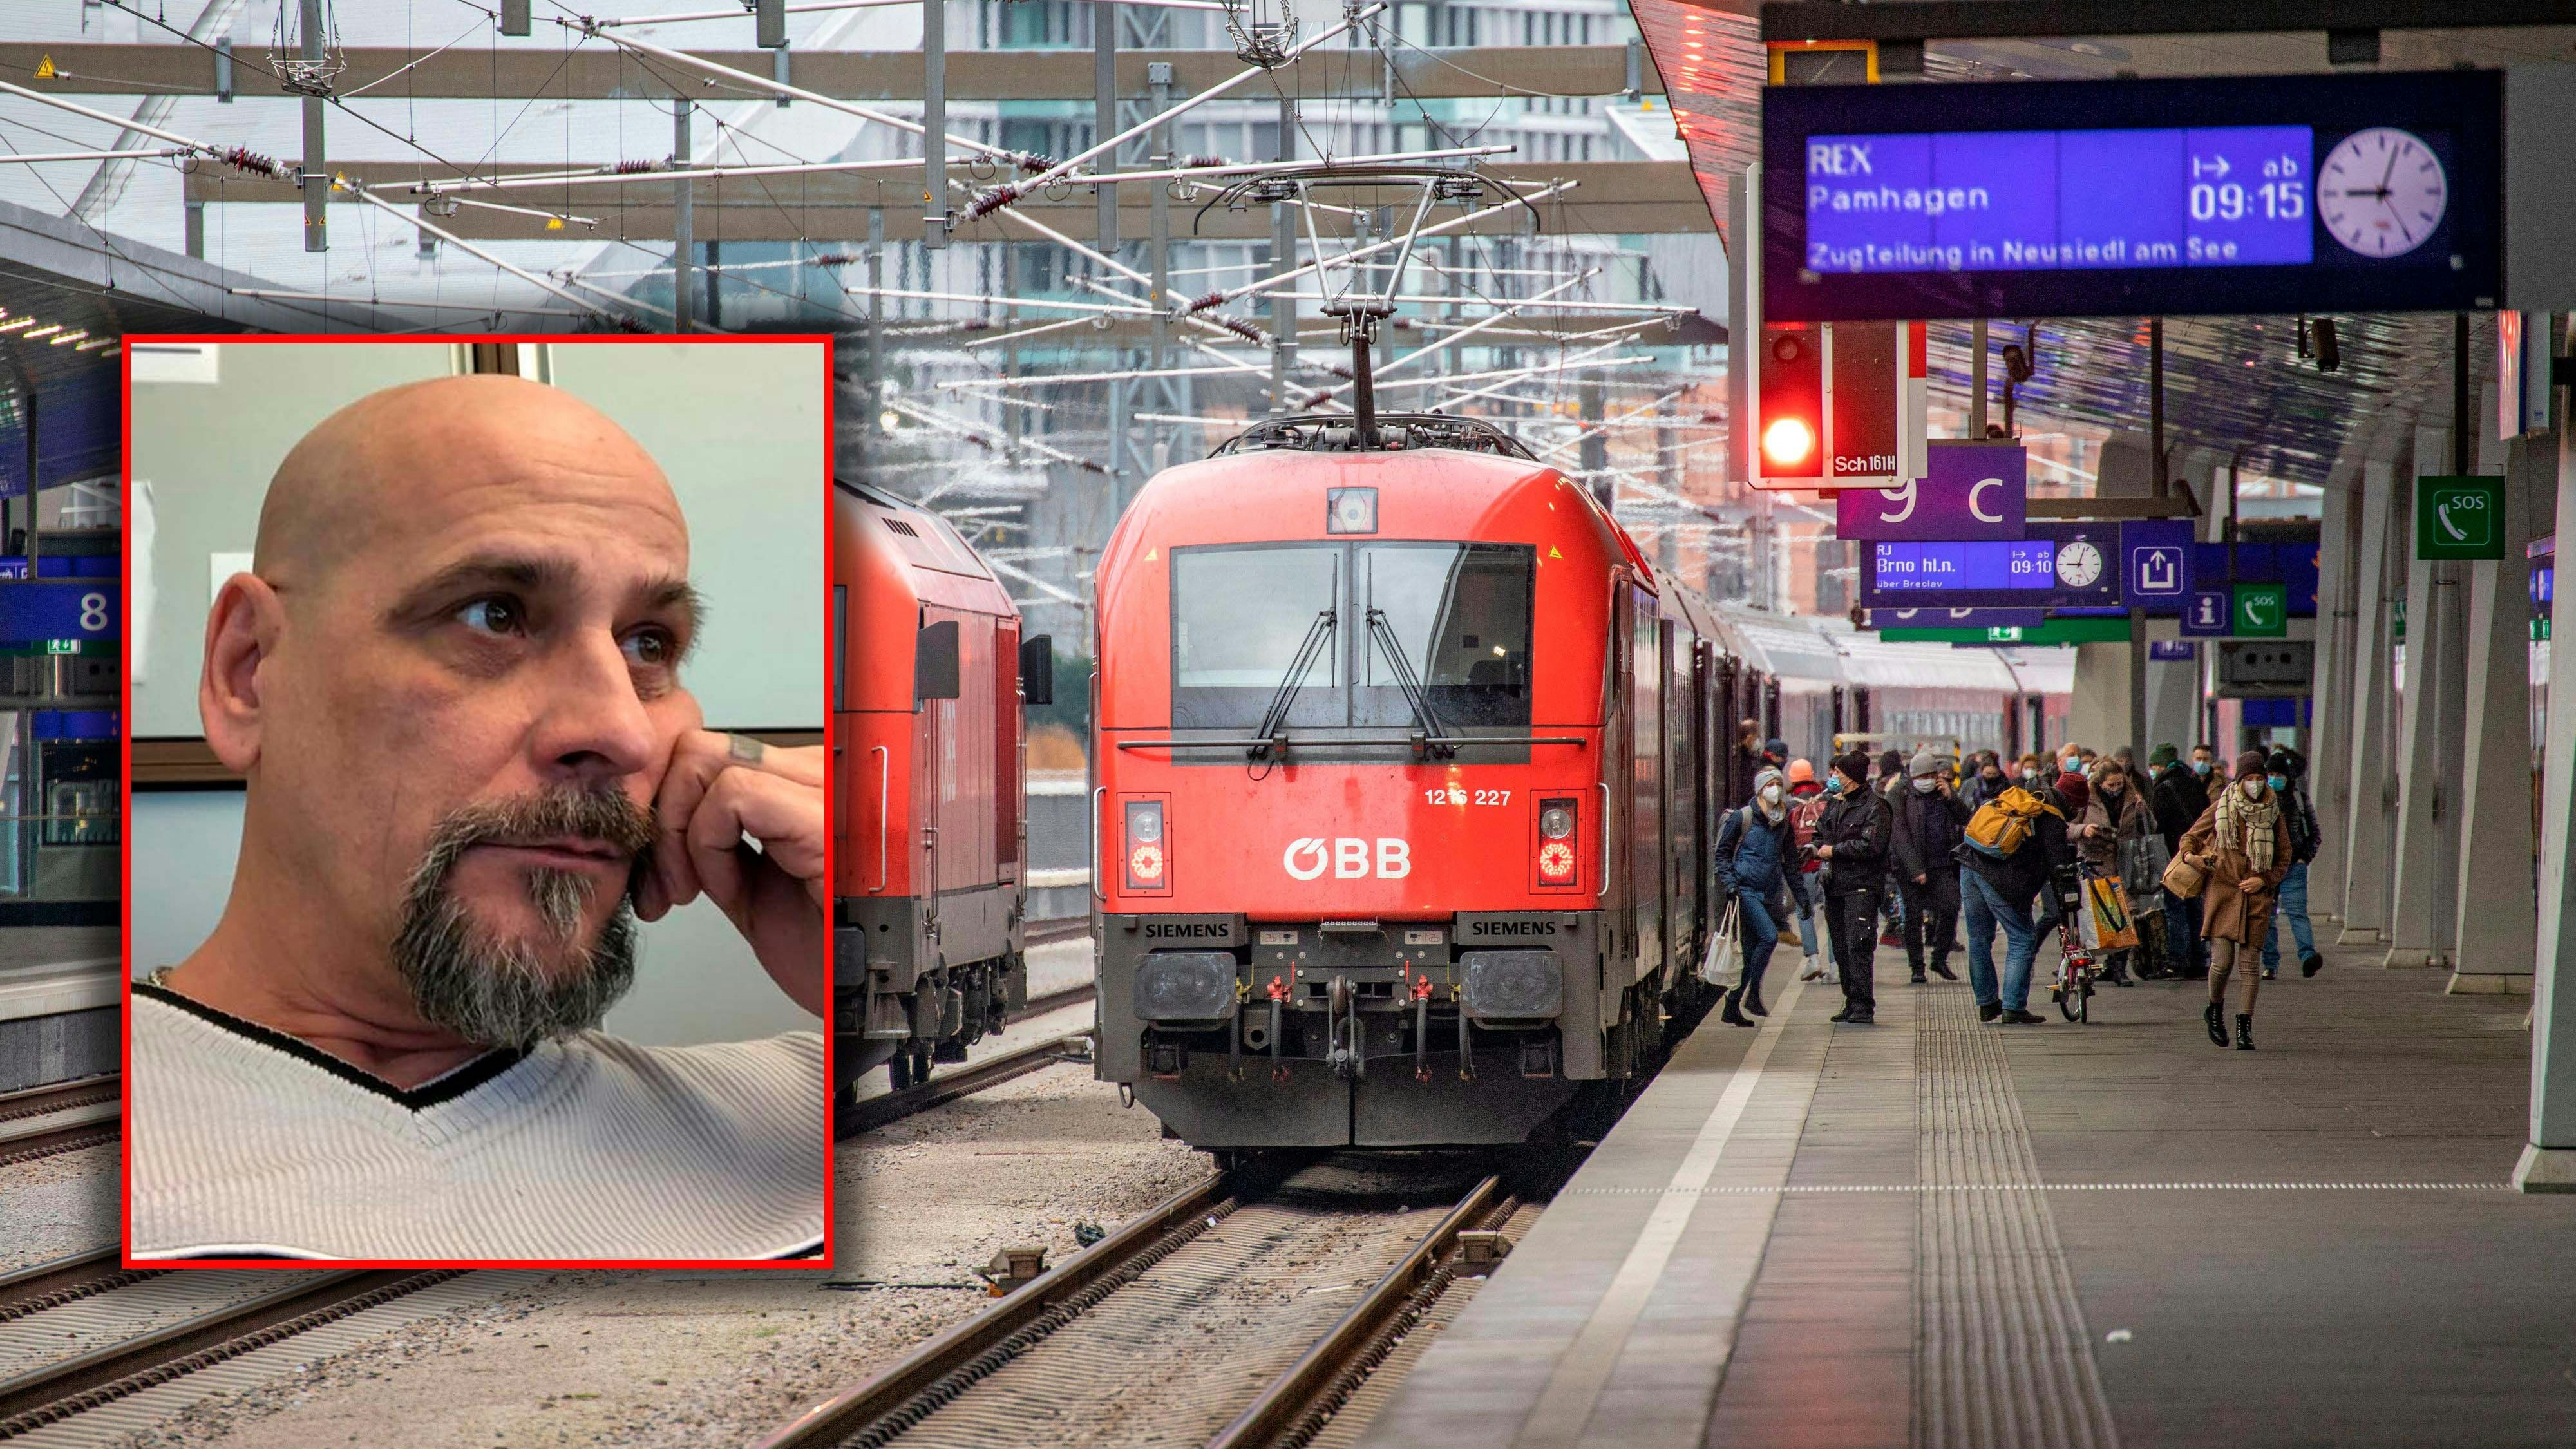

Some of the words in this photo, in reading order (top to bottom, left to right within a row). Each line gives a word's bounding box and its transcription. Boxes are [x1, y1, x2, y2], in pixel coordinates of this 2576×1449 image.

[1808, 144, 1872, 176] REX
[2263, 153, 2297, 177] ab
[1809, 183, 1989, 216] Pamhagen
[2191, 182, 2304, 220] 09:15
[1809, 242, 1959, 271] Zugteilung
[1971, 241, 1994, 265] in
[2003, 238, 2125, 263] Neusiedl
[2134, 241, 2178, 261] am
[2188, 236, 2238, 259] See
[1879, 478, 1917, 523] 9
[2452, 496, 2484, 509] SOS
[1877, 544, 1892, 556] RJ
[2037, 550, 2050, 558] ab
[1877, 558, 1915, 573] Brno
[1922, 558, 1956, 573] hl.n.
[2011, 560, 2052, 573] 09:10
[2254, 596, 2275, 606] SOS
[80, 592, 108, 631] 8
[1425, 789, 1468, 805] 1216
[1475, 790, 1511, 806] 227
[1283, 838, 1411, 881] ÖBB
[1146, 923, 1229, 938] SIEMENS
[1472, 921, 1556, 935] SIEMENS
